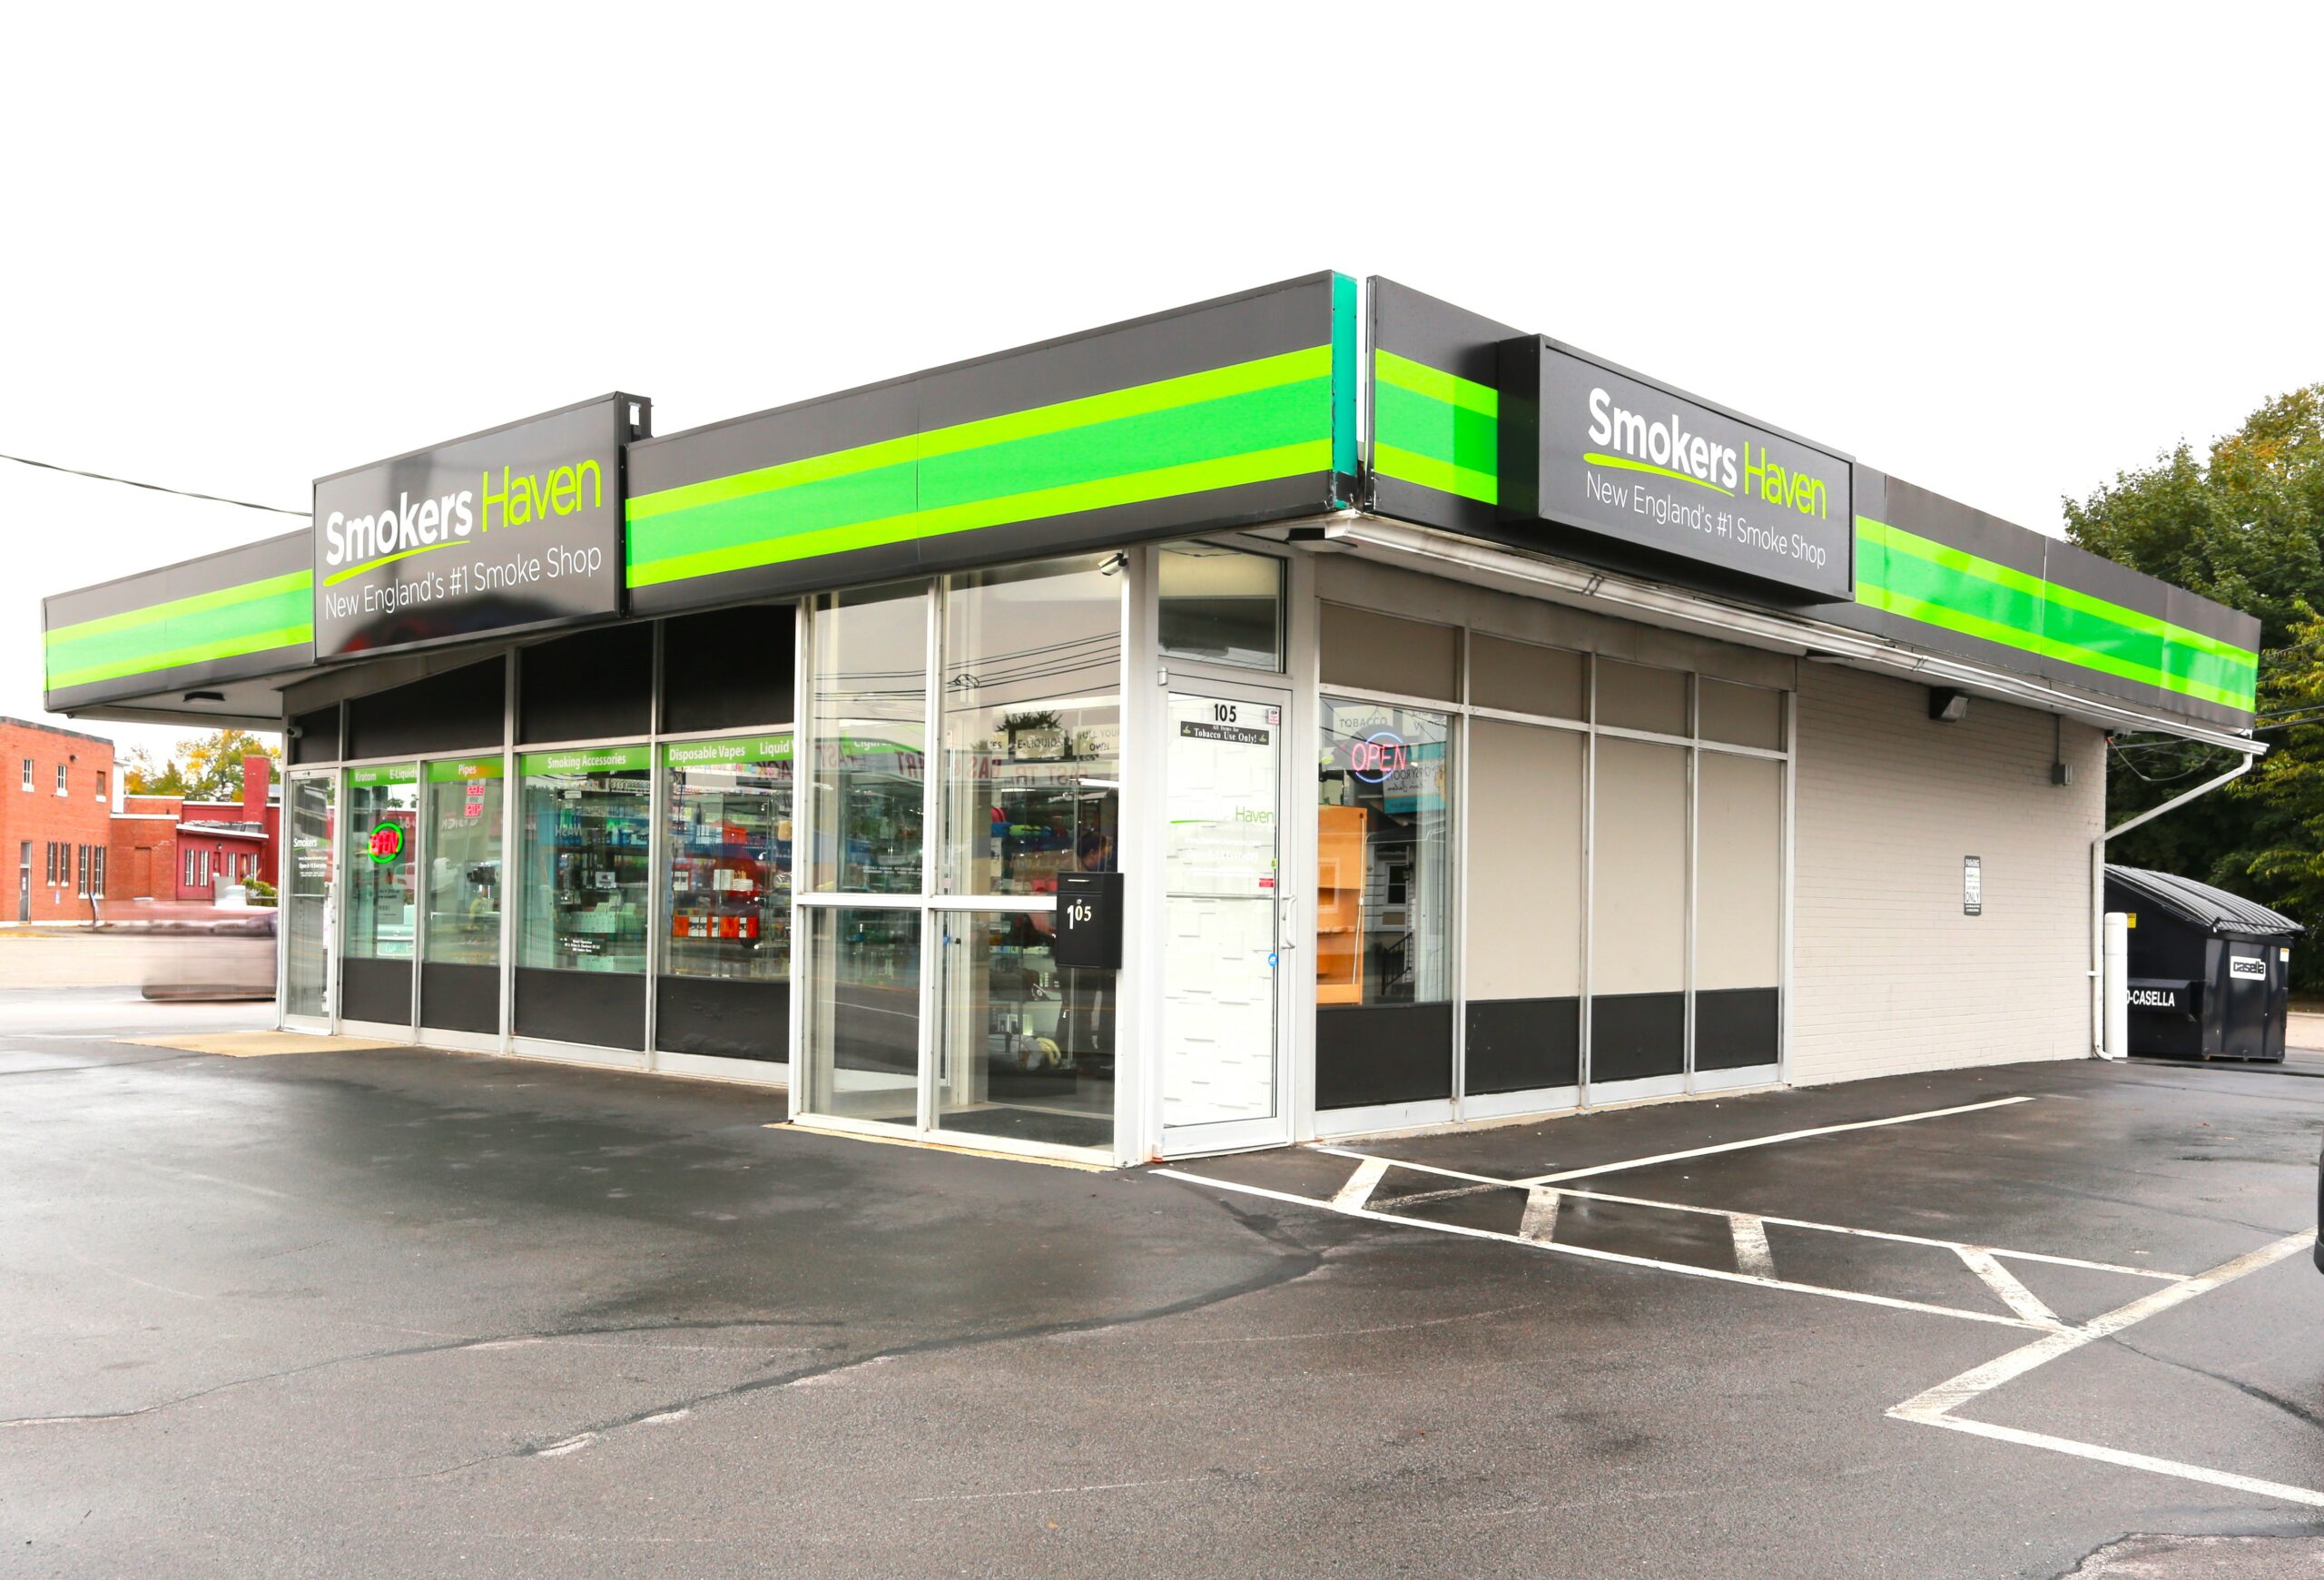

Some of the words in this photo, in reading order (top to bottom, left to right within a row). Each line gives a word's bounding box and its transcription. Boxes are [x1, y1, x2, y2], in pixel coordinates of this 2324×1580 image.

[1588, 387, 1738, 489] Smokers
[1744, 441, 1827, 520] Haven
[326, 490, 473, 566] Smokers
[482, 459, 601, 532] Haven
[1587, 470, 1628, 508] New
[1633, 485, 1712, 534] England's
[1717, 511, 1732, 539] #1
[1737, 518, 1787, 555] Smoke
[1791, 534, 1827, 570] Shop
[326, 592, 359, 620] New
[364, 571, 445, 614] England's
[450, 565, 468, 596] #1
[474, 553, 540, 591] Smoke
[547, 545, 601, 578] Shop
[1214, 704, 1236, 723] 105
[1338, 716, 1388, 727] TOBACCO
[1194, 727, 1221, 739] Tobacco
[1224, 731, 1236, 741] Use
[1238, 733, 1257, 744] Only!
[669, 746, 717, 763] Disposable
[718, 745, 745, 760] Vapes
[759, 740, 790, 757] Liquid
[1352, 743, 1407, 772] OPEN
[458, 764, 477, 777] Pipes
[547, 755, 581, 770] Smoking
[582, 753, 626, 766] Accessories
[355, 772, 377, 783] Kratom
[1236, 805, 1275, 824] Haven
[293, 836, 318, 848] Smokers
[369, 830, 399, 856] OPEN
[1965, 891, 1980, 903] ONLY
[1067, 904, 1092, 930] 105
[2233, 960, 2266, 975] casella
